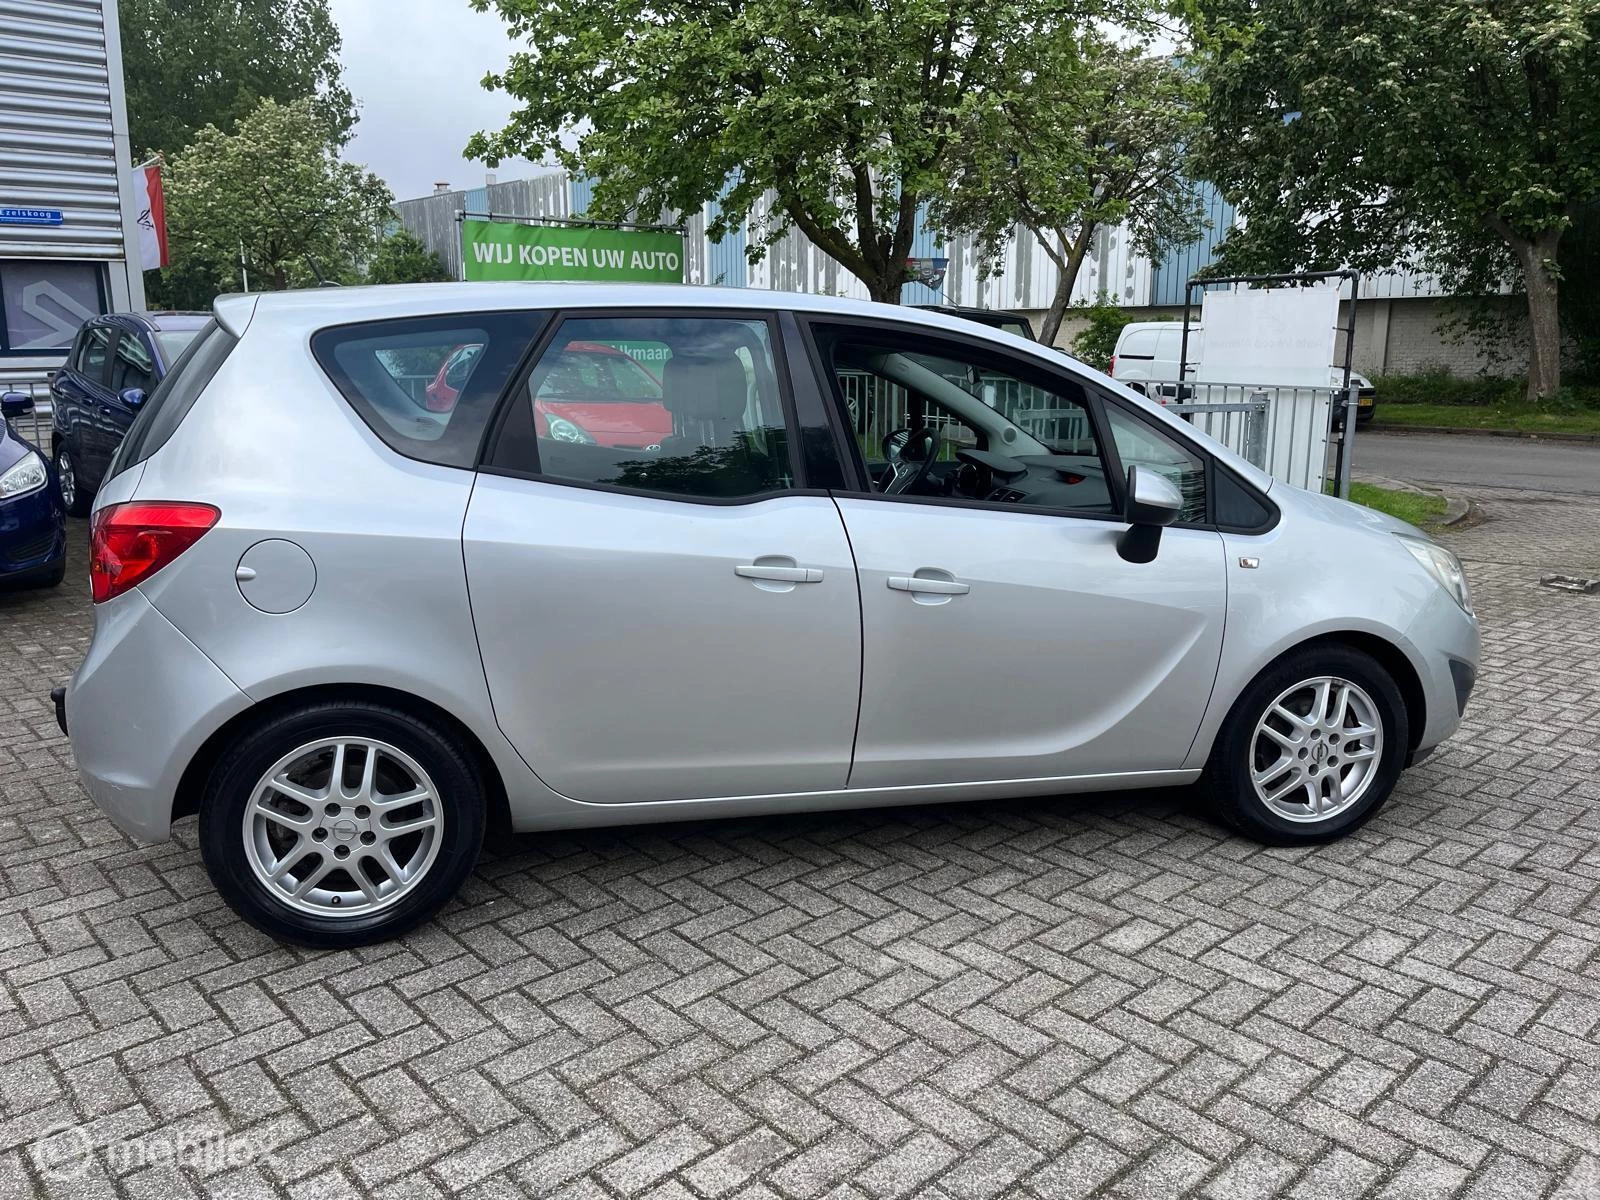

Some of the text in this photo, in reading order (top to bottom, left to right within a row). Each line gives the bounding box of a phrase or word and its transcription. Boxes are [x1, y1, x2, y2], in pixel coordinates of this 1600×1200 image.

[472, 242, 679, 271] WIJ KOPEN UW AUTO
[611, 345, 669, 361] lkmaar
